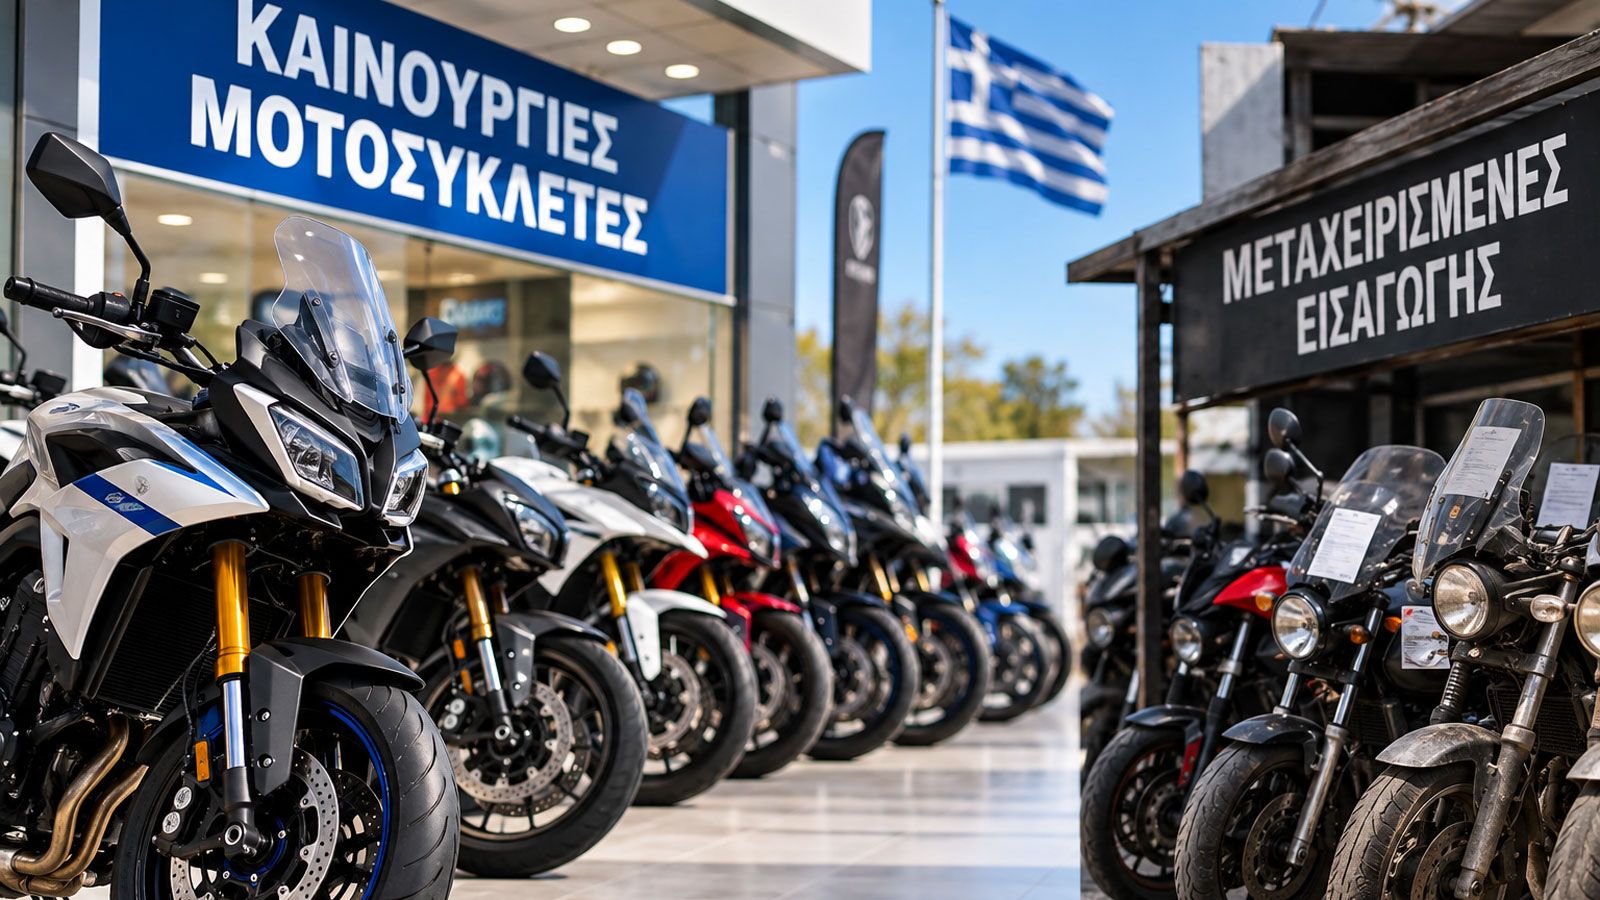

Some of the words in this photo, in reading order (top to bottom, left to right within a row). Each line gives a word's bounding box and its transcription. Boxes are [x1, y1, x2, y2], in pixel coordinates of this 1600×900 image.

[190, 74, 648, 255] ΜΟΤΟΣΥΚΛΕΤΕΣ
[237, 0, 619, 174] ΚΑΙΝΟΥΡΓΙΕΣ
[1223, 133, 1568, 304] ΜΕΤΑΧΕΙΡΙΣΜΕΝΕΣ
[1297, 241, 1502, 355] ΕΙΣΑΓΩΓΗΣ
